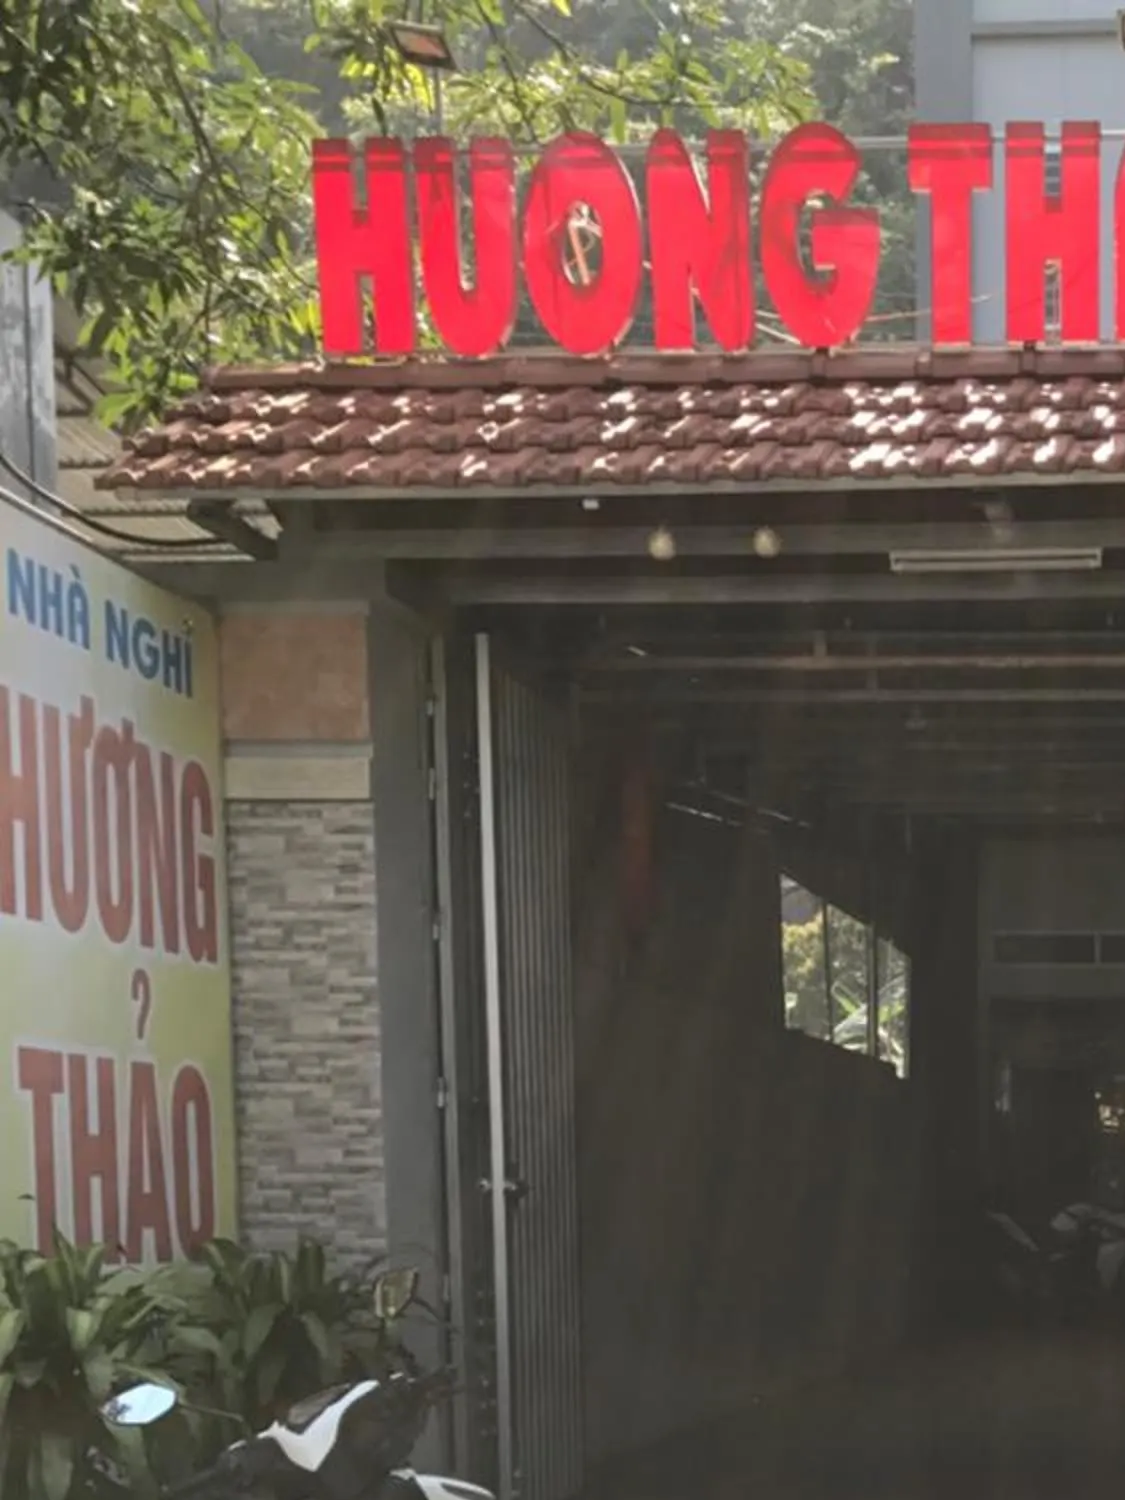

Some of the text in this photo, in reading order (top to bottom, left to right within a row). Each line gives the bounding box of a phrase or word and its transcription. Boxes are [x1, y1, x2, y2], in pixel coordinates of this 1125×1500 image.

[312, 121, 880, 360] HUONG
[8, 547, 194, 698] NHÀ NGHỈ
[0, 684, 219, 966] HƯƠNG
[18, 967, 217, 1264] THẢO
